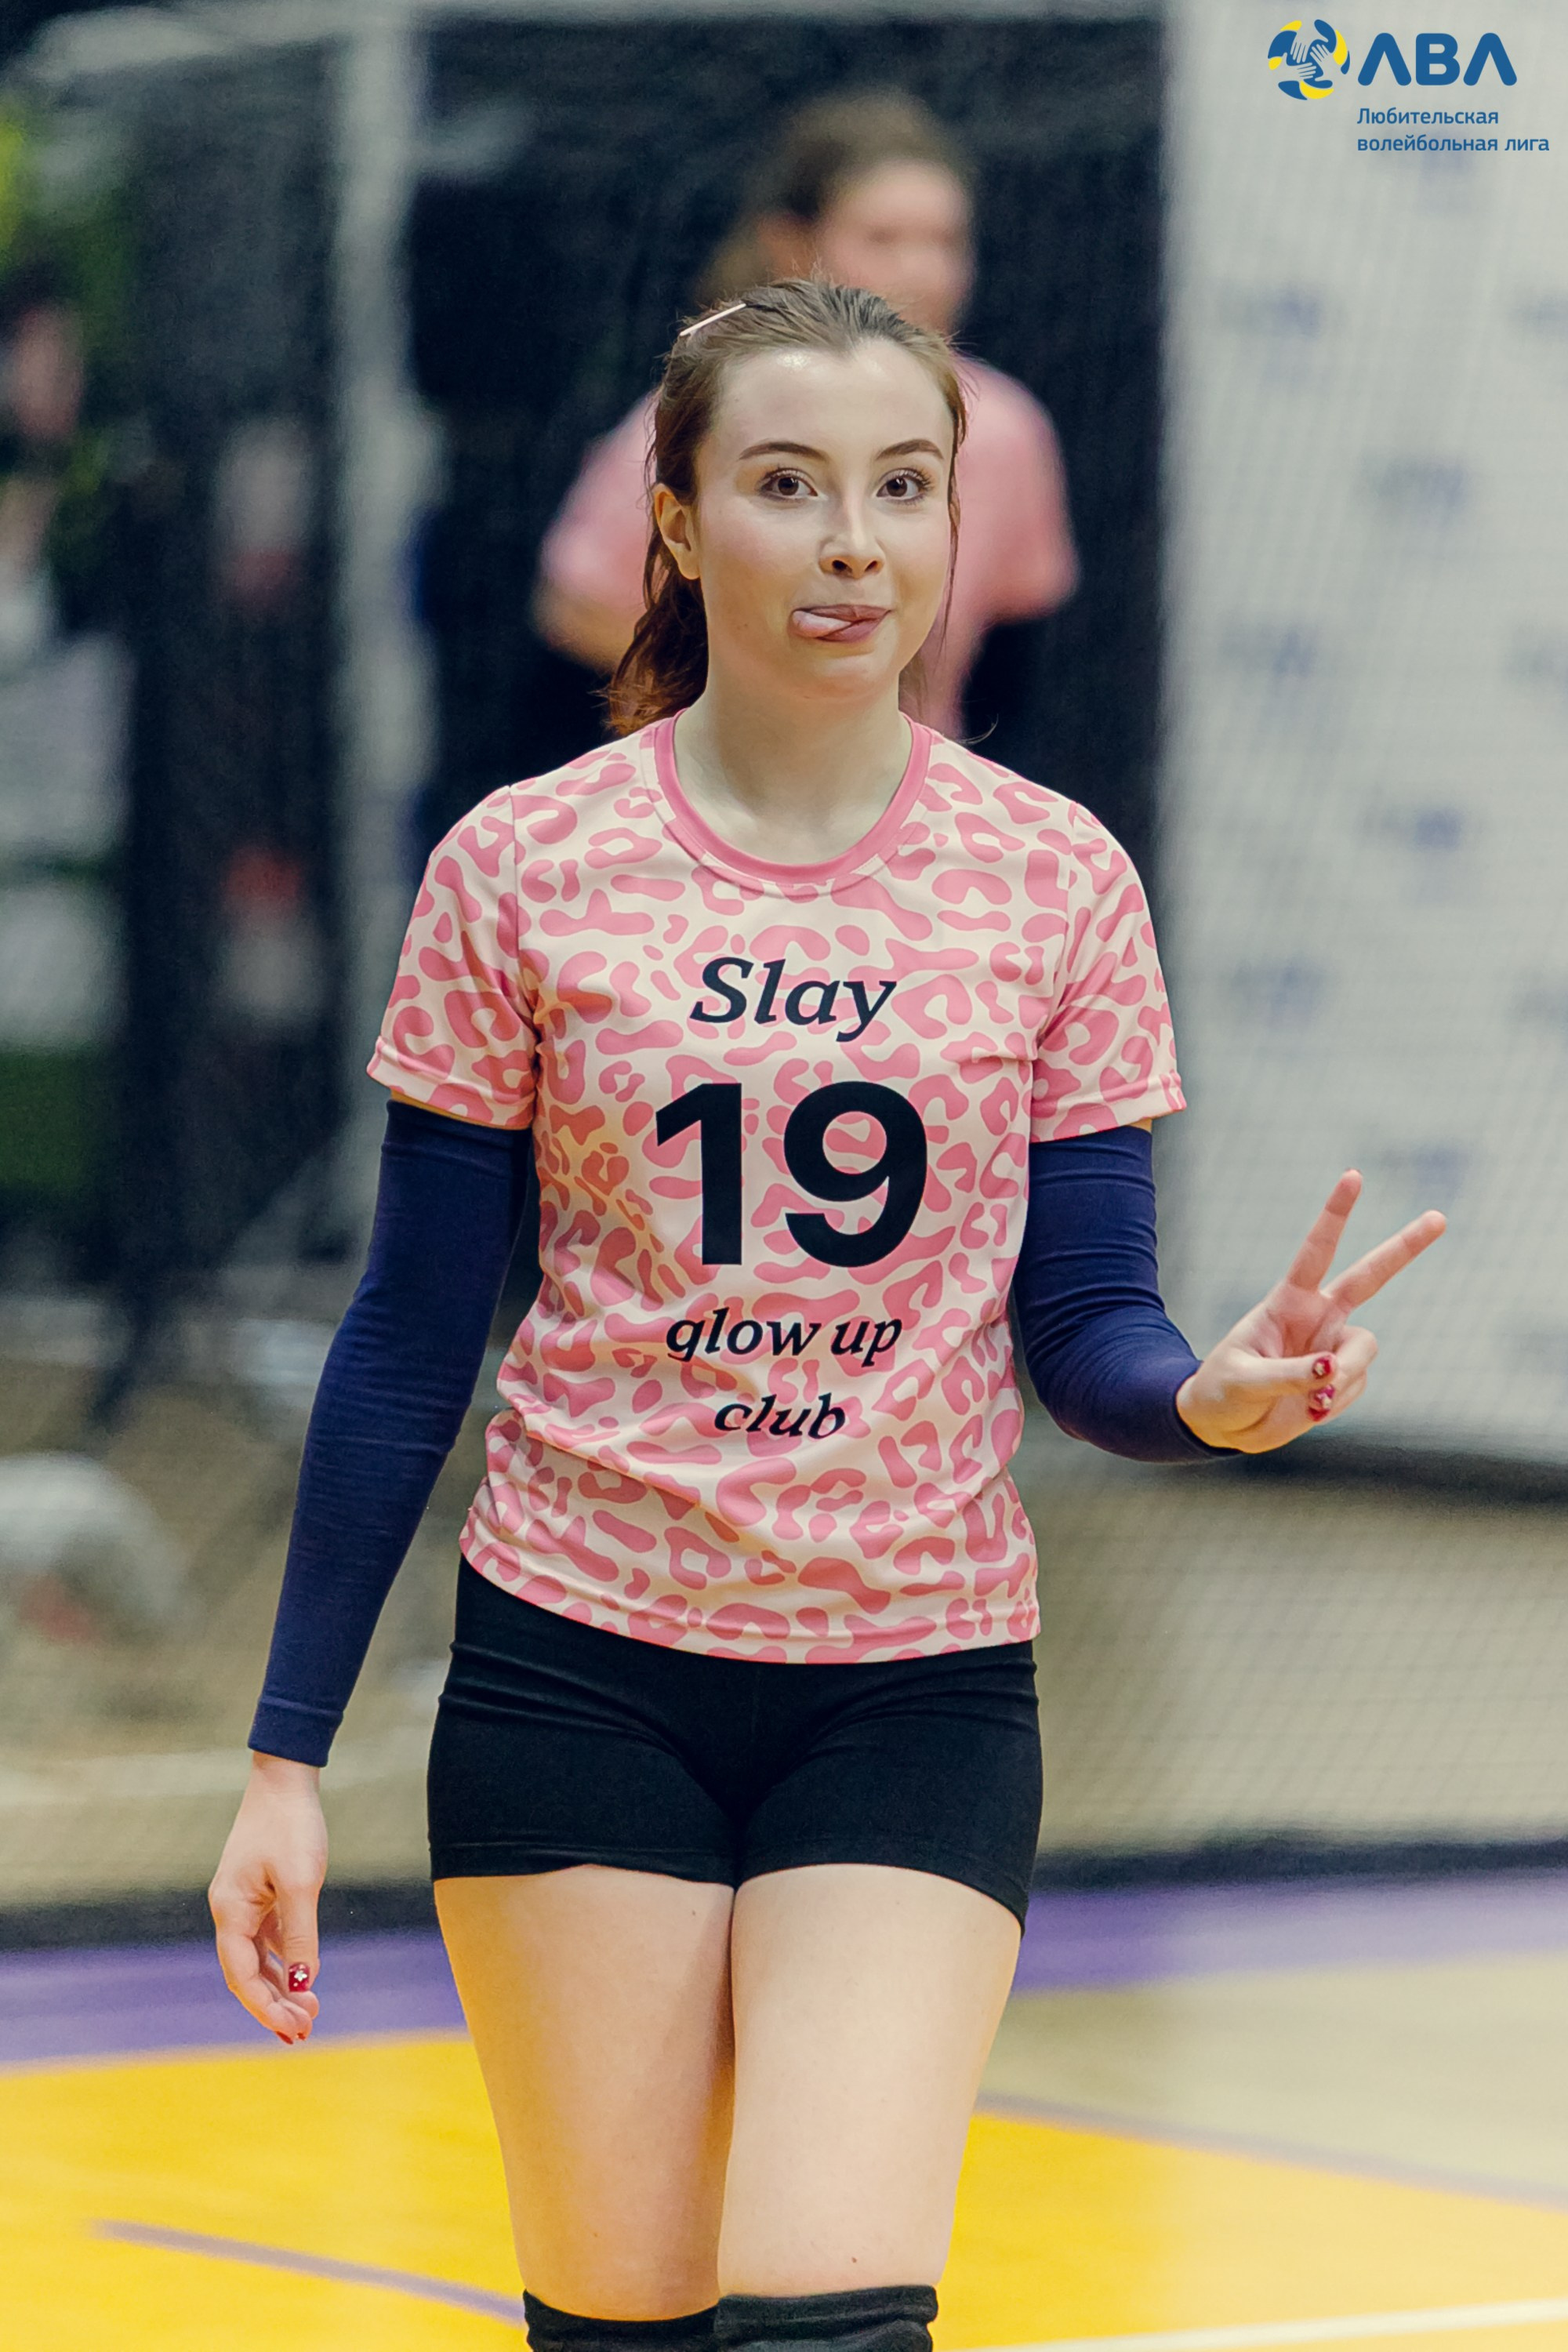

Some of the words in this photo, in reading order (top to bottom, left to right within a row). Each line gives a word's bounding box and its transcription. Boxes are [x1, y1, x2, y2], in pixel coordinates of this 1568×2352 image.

[689, 956, 897, 1042] Slay
[655, 1081, 927, 1268] 19
[666, 1307, 822, 1362] glow
[831, 1319, 902, 1367] up
[714, 1392, 846, 1439] club
